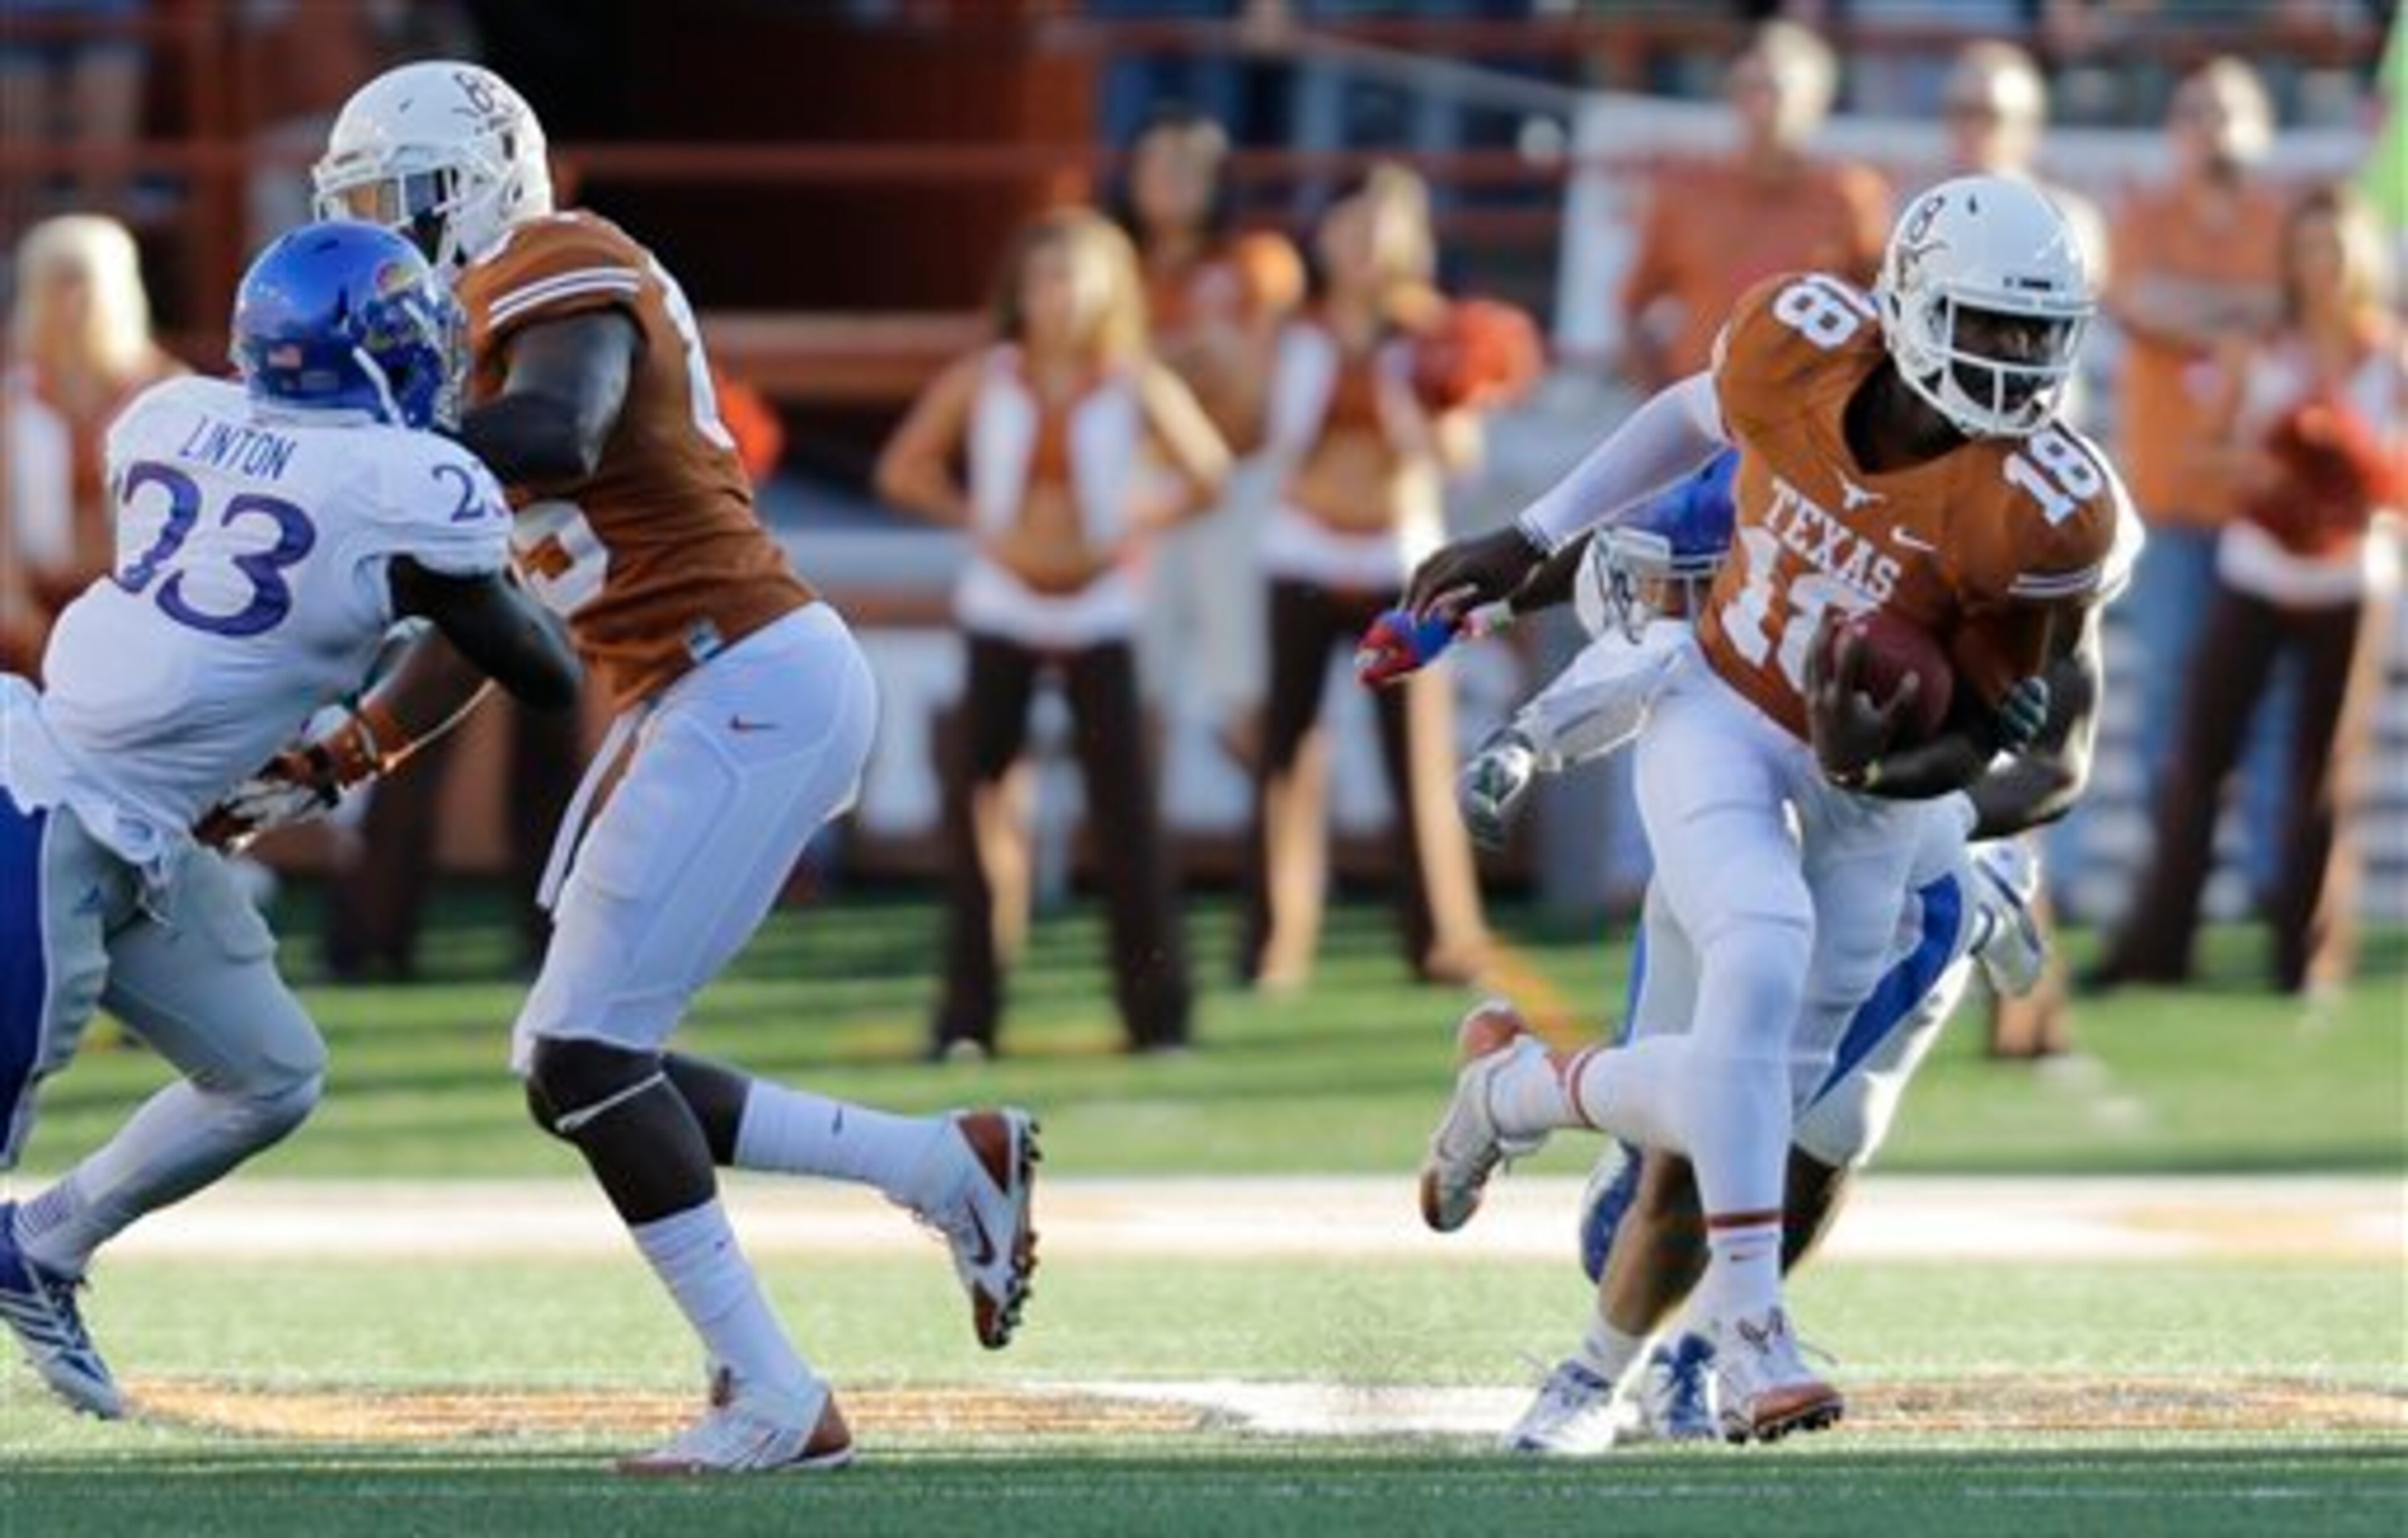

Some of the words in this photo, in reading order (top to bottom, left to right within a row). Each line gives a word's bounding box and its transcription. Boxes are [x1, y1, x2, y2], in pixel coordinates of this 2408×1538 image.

[179, 414, 298, 481] LINTON
[431, 463, 504, 523] 2
[2002, 430, 2102, 528] 18
[115, 461, 316, 638] 23
[1762, 474, 1902, 604] TEXAS
